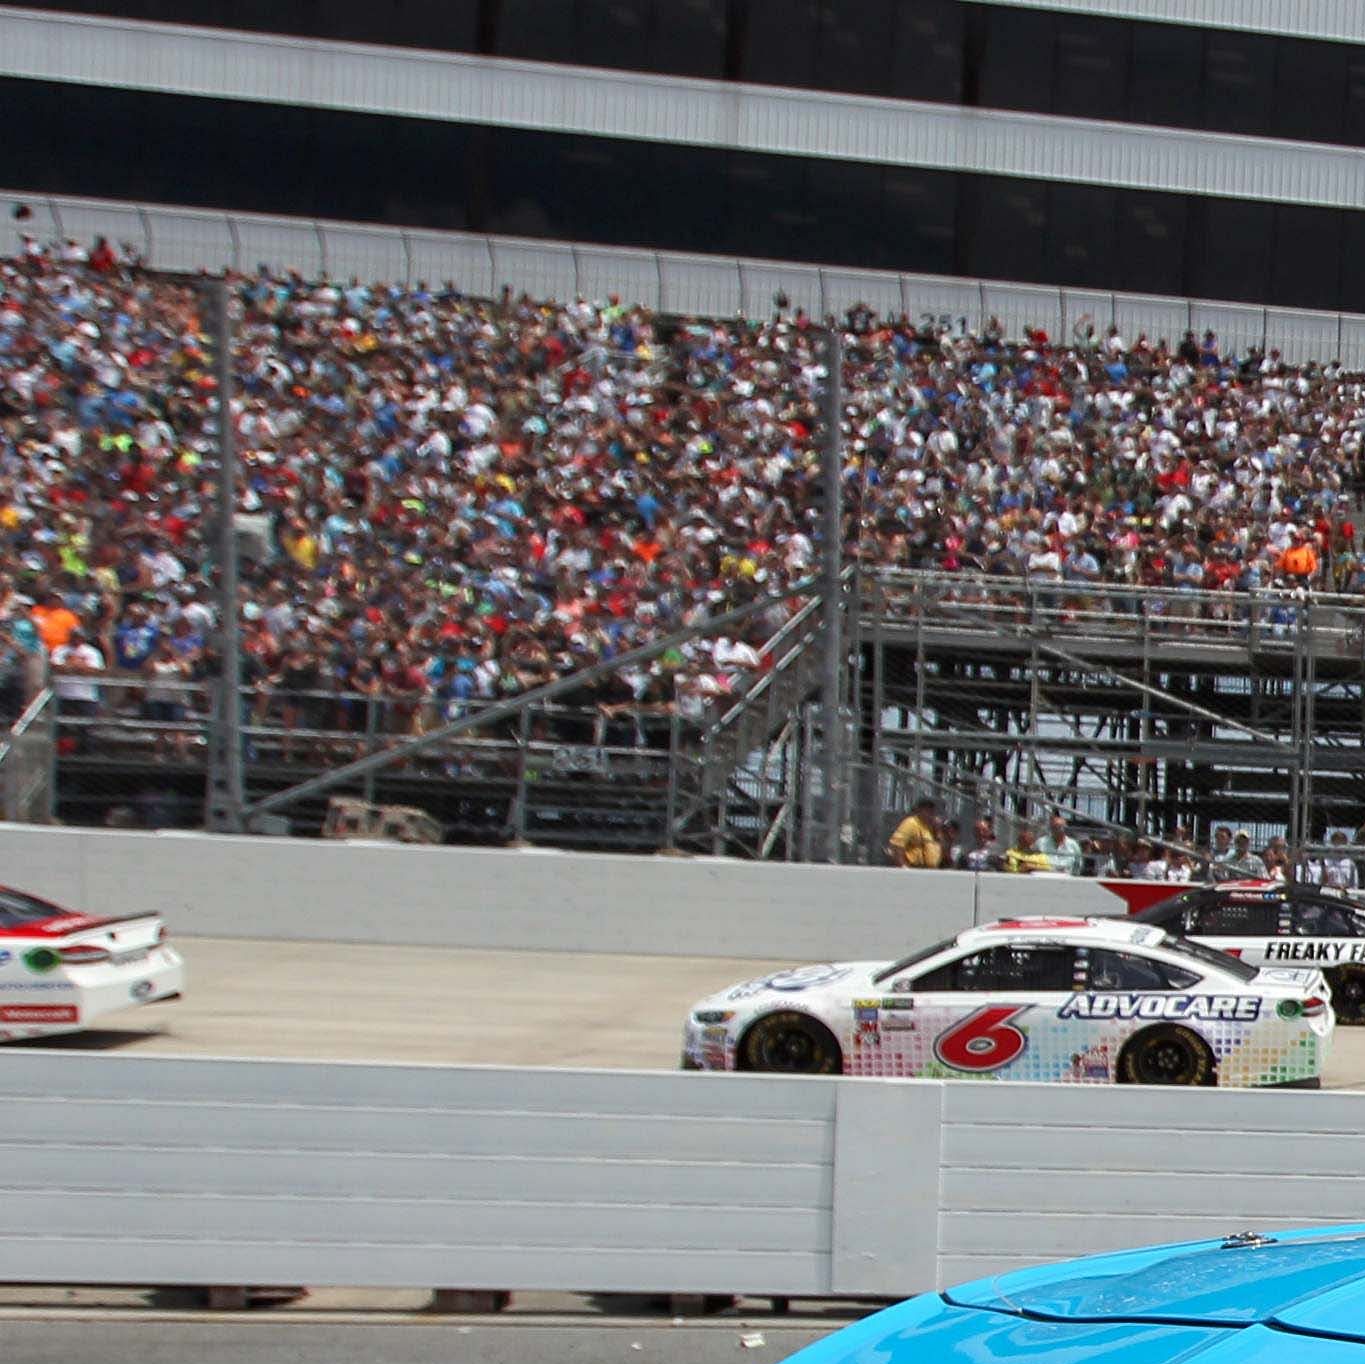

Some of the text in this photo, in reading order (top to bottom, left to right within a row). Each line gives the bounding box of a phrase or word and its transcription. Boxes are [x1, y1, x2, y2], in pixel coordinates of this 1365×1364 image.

[1264, 941, 1345, 961] FREAKY
[1057, 992, 1263, 1021] ADVOCARE
[934, 1003, 1037, 1073] 6
